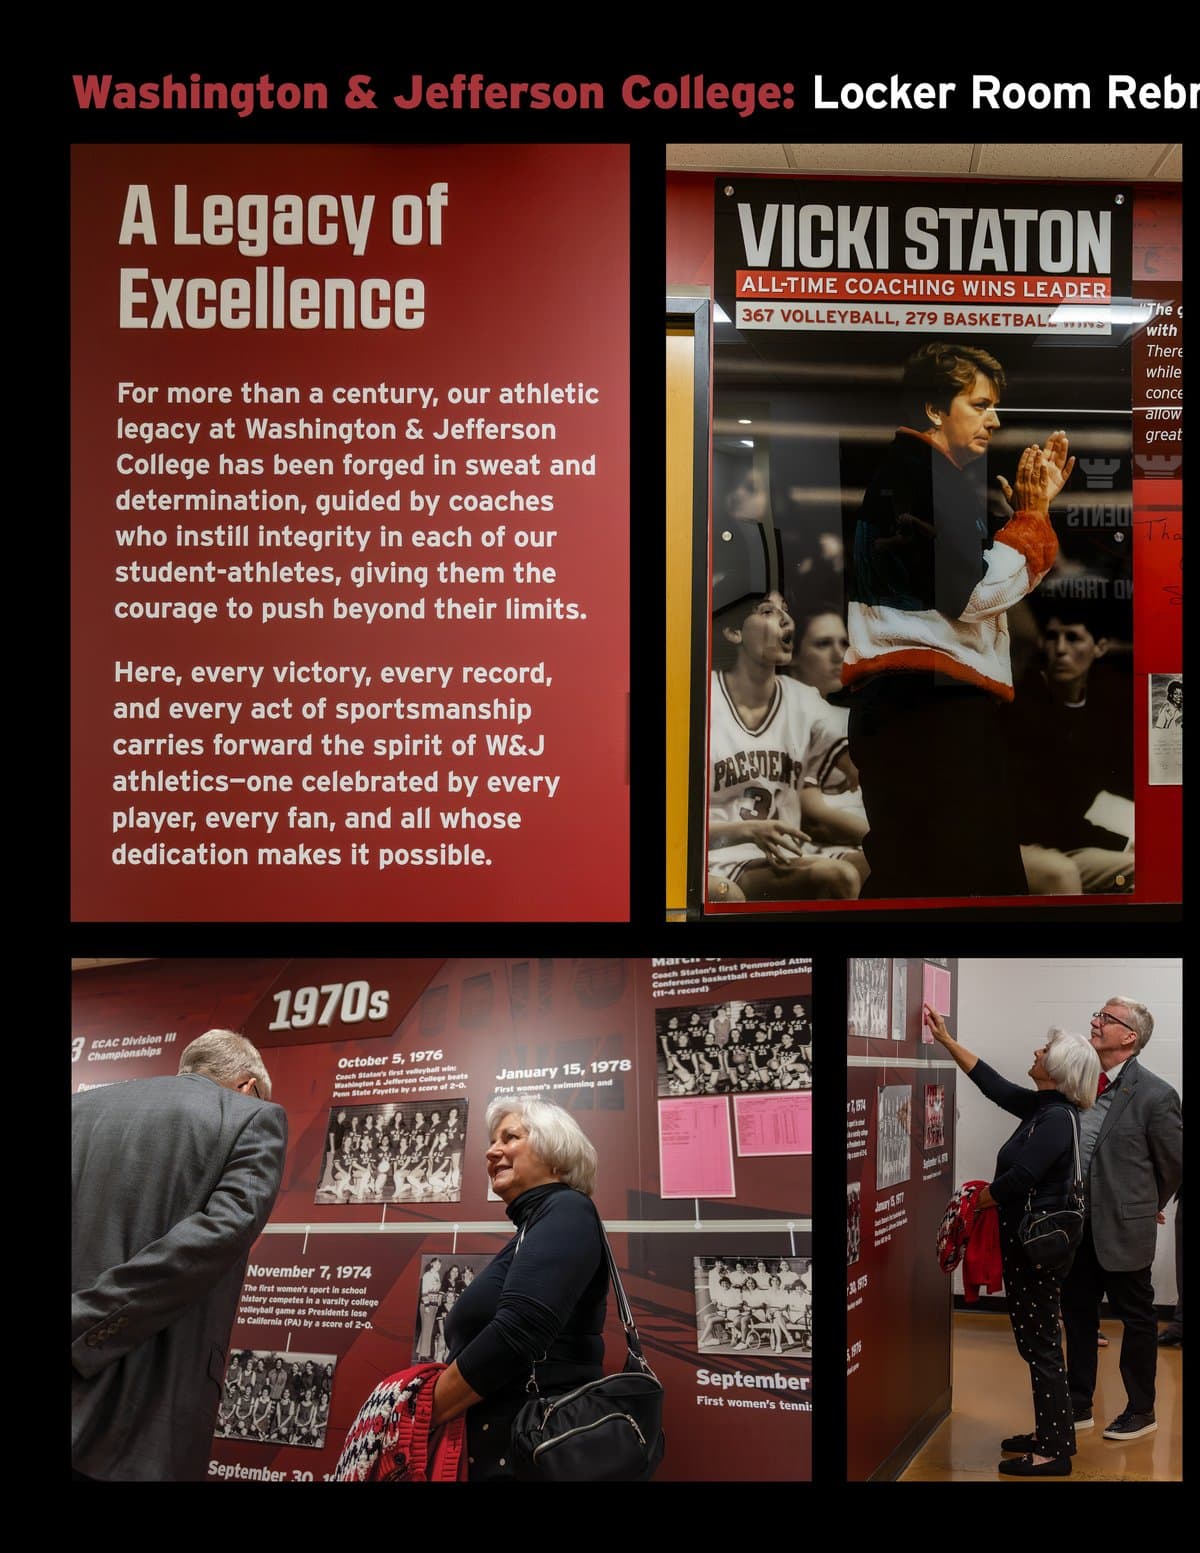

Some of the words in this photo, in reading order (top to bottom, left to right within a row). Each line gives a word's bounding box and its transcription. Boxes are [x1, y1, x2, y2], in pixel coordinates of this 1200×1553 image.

[118, 184, 157, 244] A
[174, 184, 375, 256] Legacy
[392, 182, 448, 245] of
[737, 203, 888, 269] VICKI
[905, 207, 1111, 274] STATON
[741, 276, 837, 293] ALL-TIME
[845, 278, 954, 295] COACHING
[962, 280, 1015, 296] WINS
[1024, 281, 1108, 301] LEADER
[120, 266, 424, 329] Excellence
[742, 307, 775, 323] 367
[780, 309, 900, 327] VOLLEYBALL,
[905, 311, 938, 325] 279
[1146, 323, 1178, 337] with
[1146, 344, 1183, 358] There
[1146, 365, 1182, 379] while
[118, 382, 158, 403] For
[168, 387, 232, 403] more
[241, 382, 299, 403] than
[309, 387, 323, 403] a
[332, 382, 438, 408] century,
[448, 387, 490, 403] our
[499, 382, 599, 403] athletic
[1146, 408, 1181, 420] allow
[117, 417, 200, 443] legacy
[209, 418, 235, 438] at
[245, 418, 395, 444] Washington
[405, 418, 424, 439] &
[433, 418, 555, 439] Jefferson
[1146, 429, 1183, 443] great
[652, 978, 700, 988] Conference
[702, 972, 747, 982] basketball
[269, 981, 389, 1029] 1970s
[91, 1038, 119, 1048] ECAC
[122, 1034, 161, 1046] Division
[164, 1032, 176, 1042] III
[88, 1046, 161, 1061] Championships
[338, 1056, 388, 1068] October
[392, 1053, 404, 1064] 5,
[410, 1049, 443, 1062] 1976
[405, 1066, 439, 1074] volleyball
[496, 1067, 558, 1080] January
[563, 1063, 585, 1075] 15,
[590, 1059, 631, 1073] 1978
[516, 1083, 550, 1091] women's
[553, 1080, 594, 1089] swimming
[247, 1264, 315, 1277] November
[320, 1265, 330, 1280] 7,
[336, 1266, 371, 1278] 1974
[259, 1284, 274, 1292] first
[309, 1286, 330, 1294] sport
[341, 1286, 366, 1294] school
[696, 1369, 809, 1390] September
[697, 1395, 723, 1406] First
[727, 1400, 775, 1409] women's
